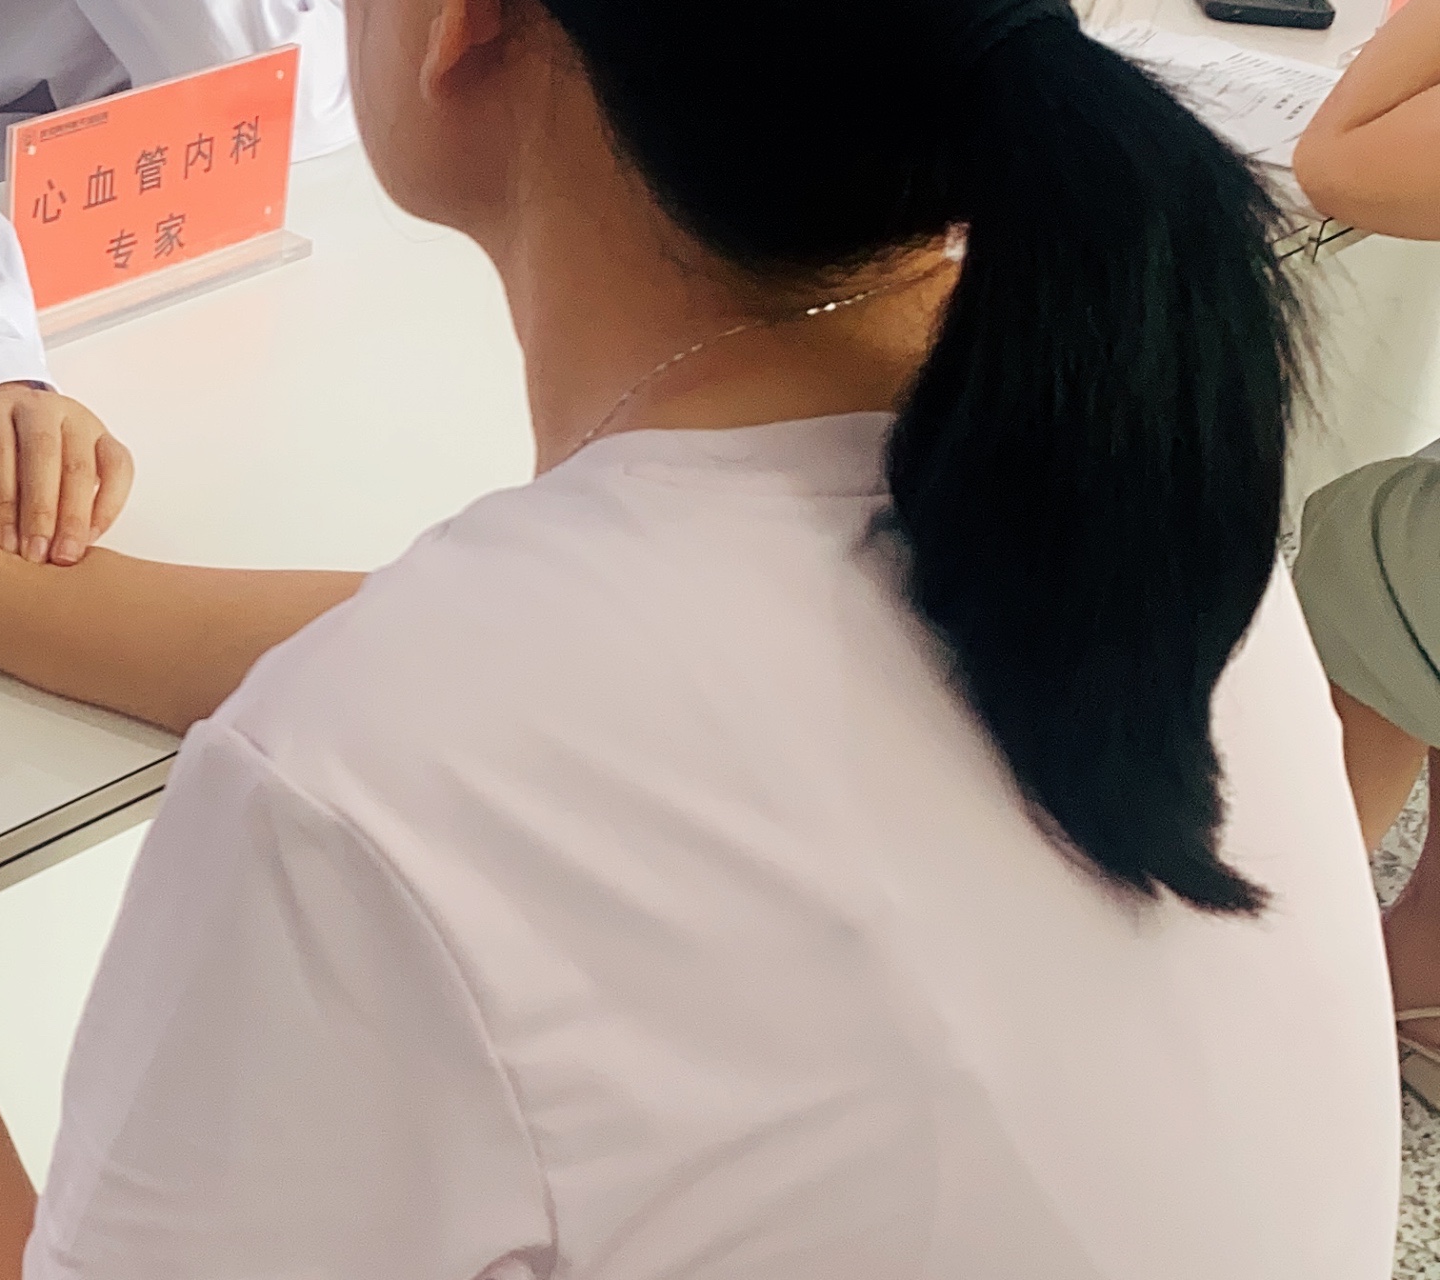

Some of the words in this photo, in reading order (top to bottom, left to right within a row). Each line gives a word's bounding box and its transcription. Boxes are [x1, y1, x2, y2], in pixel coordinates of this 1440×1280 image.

[32, 115, 261, 224] 心血管内科
[106, 213, 186, 269] 专家
